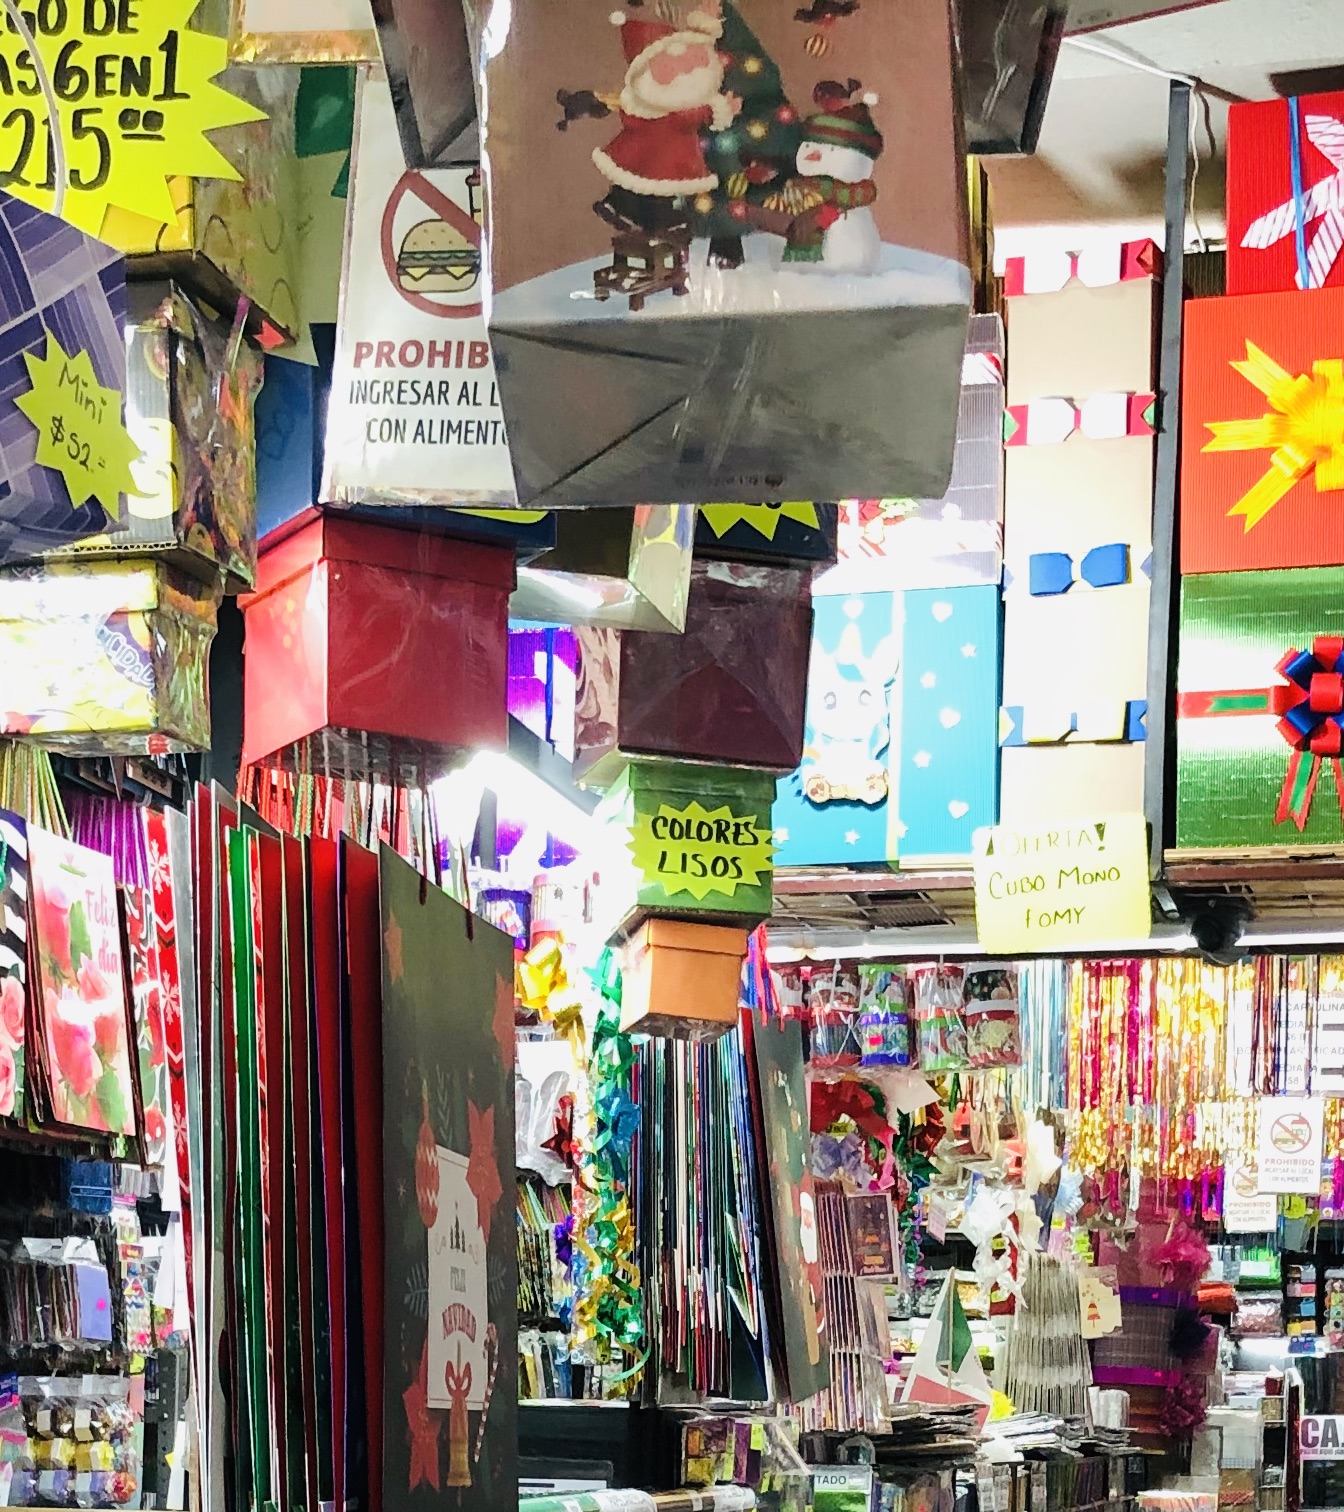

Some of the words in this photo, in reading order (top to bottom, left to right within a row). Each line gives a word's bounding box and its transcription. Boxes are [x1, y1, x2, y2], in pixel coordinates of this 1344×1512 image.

[353, 340, 490, 369] PROHIB
[349, 379, 450, 407] INGRESAR
[458, 381, 484, 407] AL
[366, 417, 408, 444] CON
[650, 814, 759, 847] COLORES
[657, 849, 744, 880] LISOS
[1264, 1158, 1316, 1167] PROHIBIDO
[816, 1474, 847, 1485] TADO
